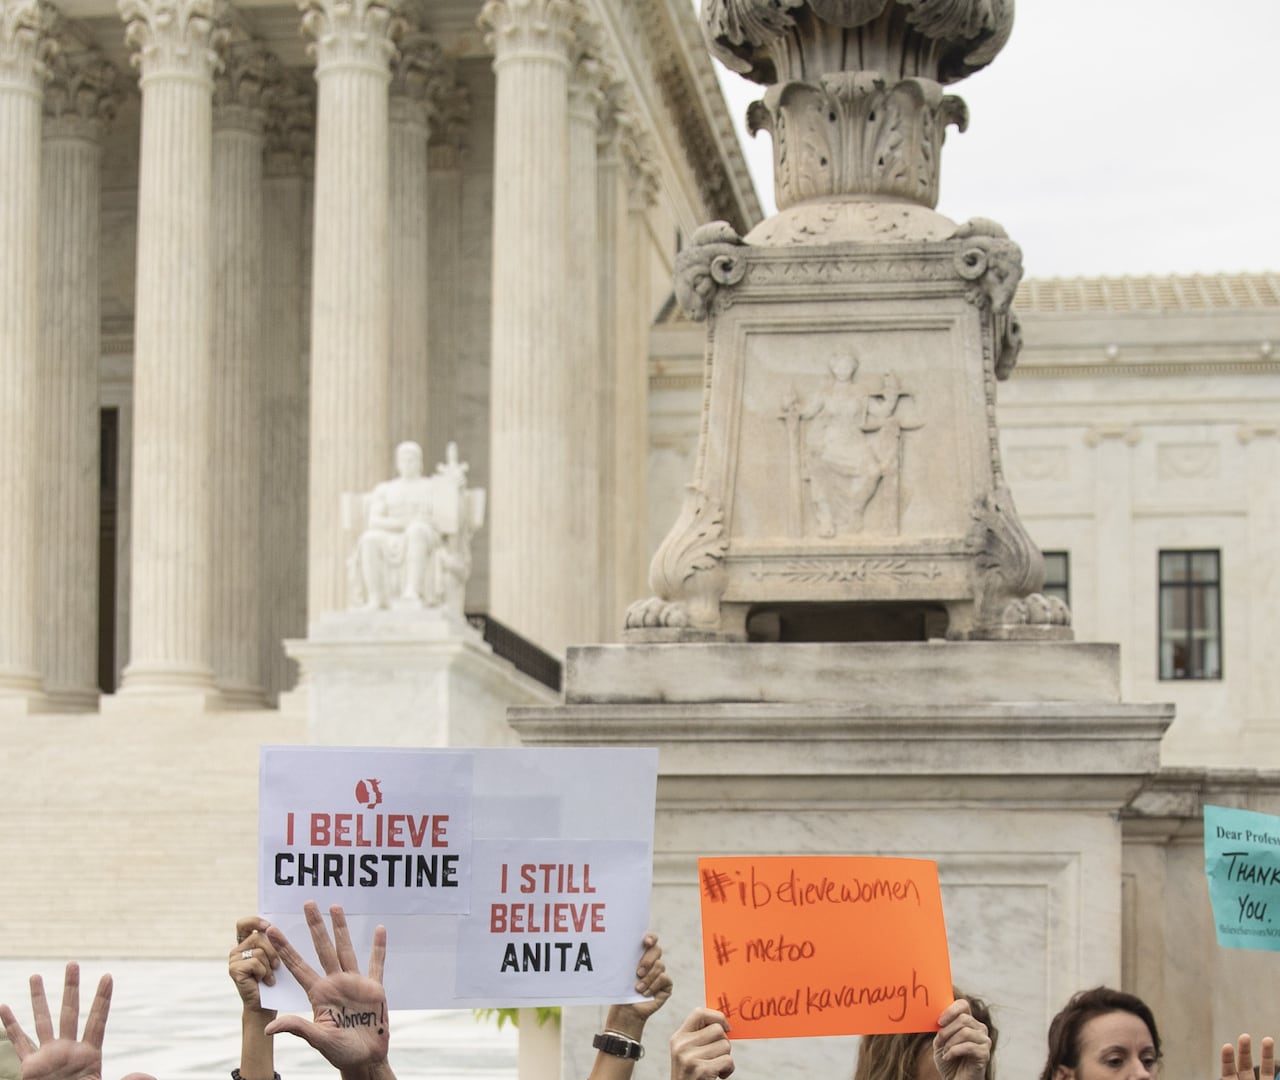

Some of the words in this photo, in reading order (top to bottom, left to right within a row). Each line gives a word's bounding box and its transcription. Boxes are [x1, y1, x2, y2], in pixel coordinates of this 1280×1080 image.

[286, 812, 295, 846] I
[309, 812, 450, 848] BELIEVE
[1216, 826, 1242, 841] Dear
[273, 852, 460, 888] CHRISTINE
[500, 863, 509, 894] I
[519, 863, 597, 894] STILL
[489, 902, 607, 933] BELIEVE
[500, 942, 594, 973] ANITA
